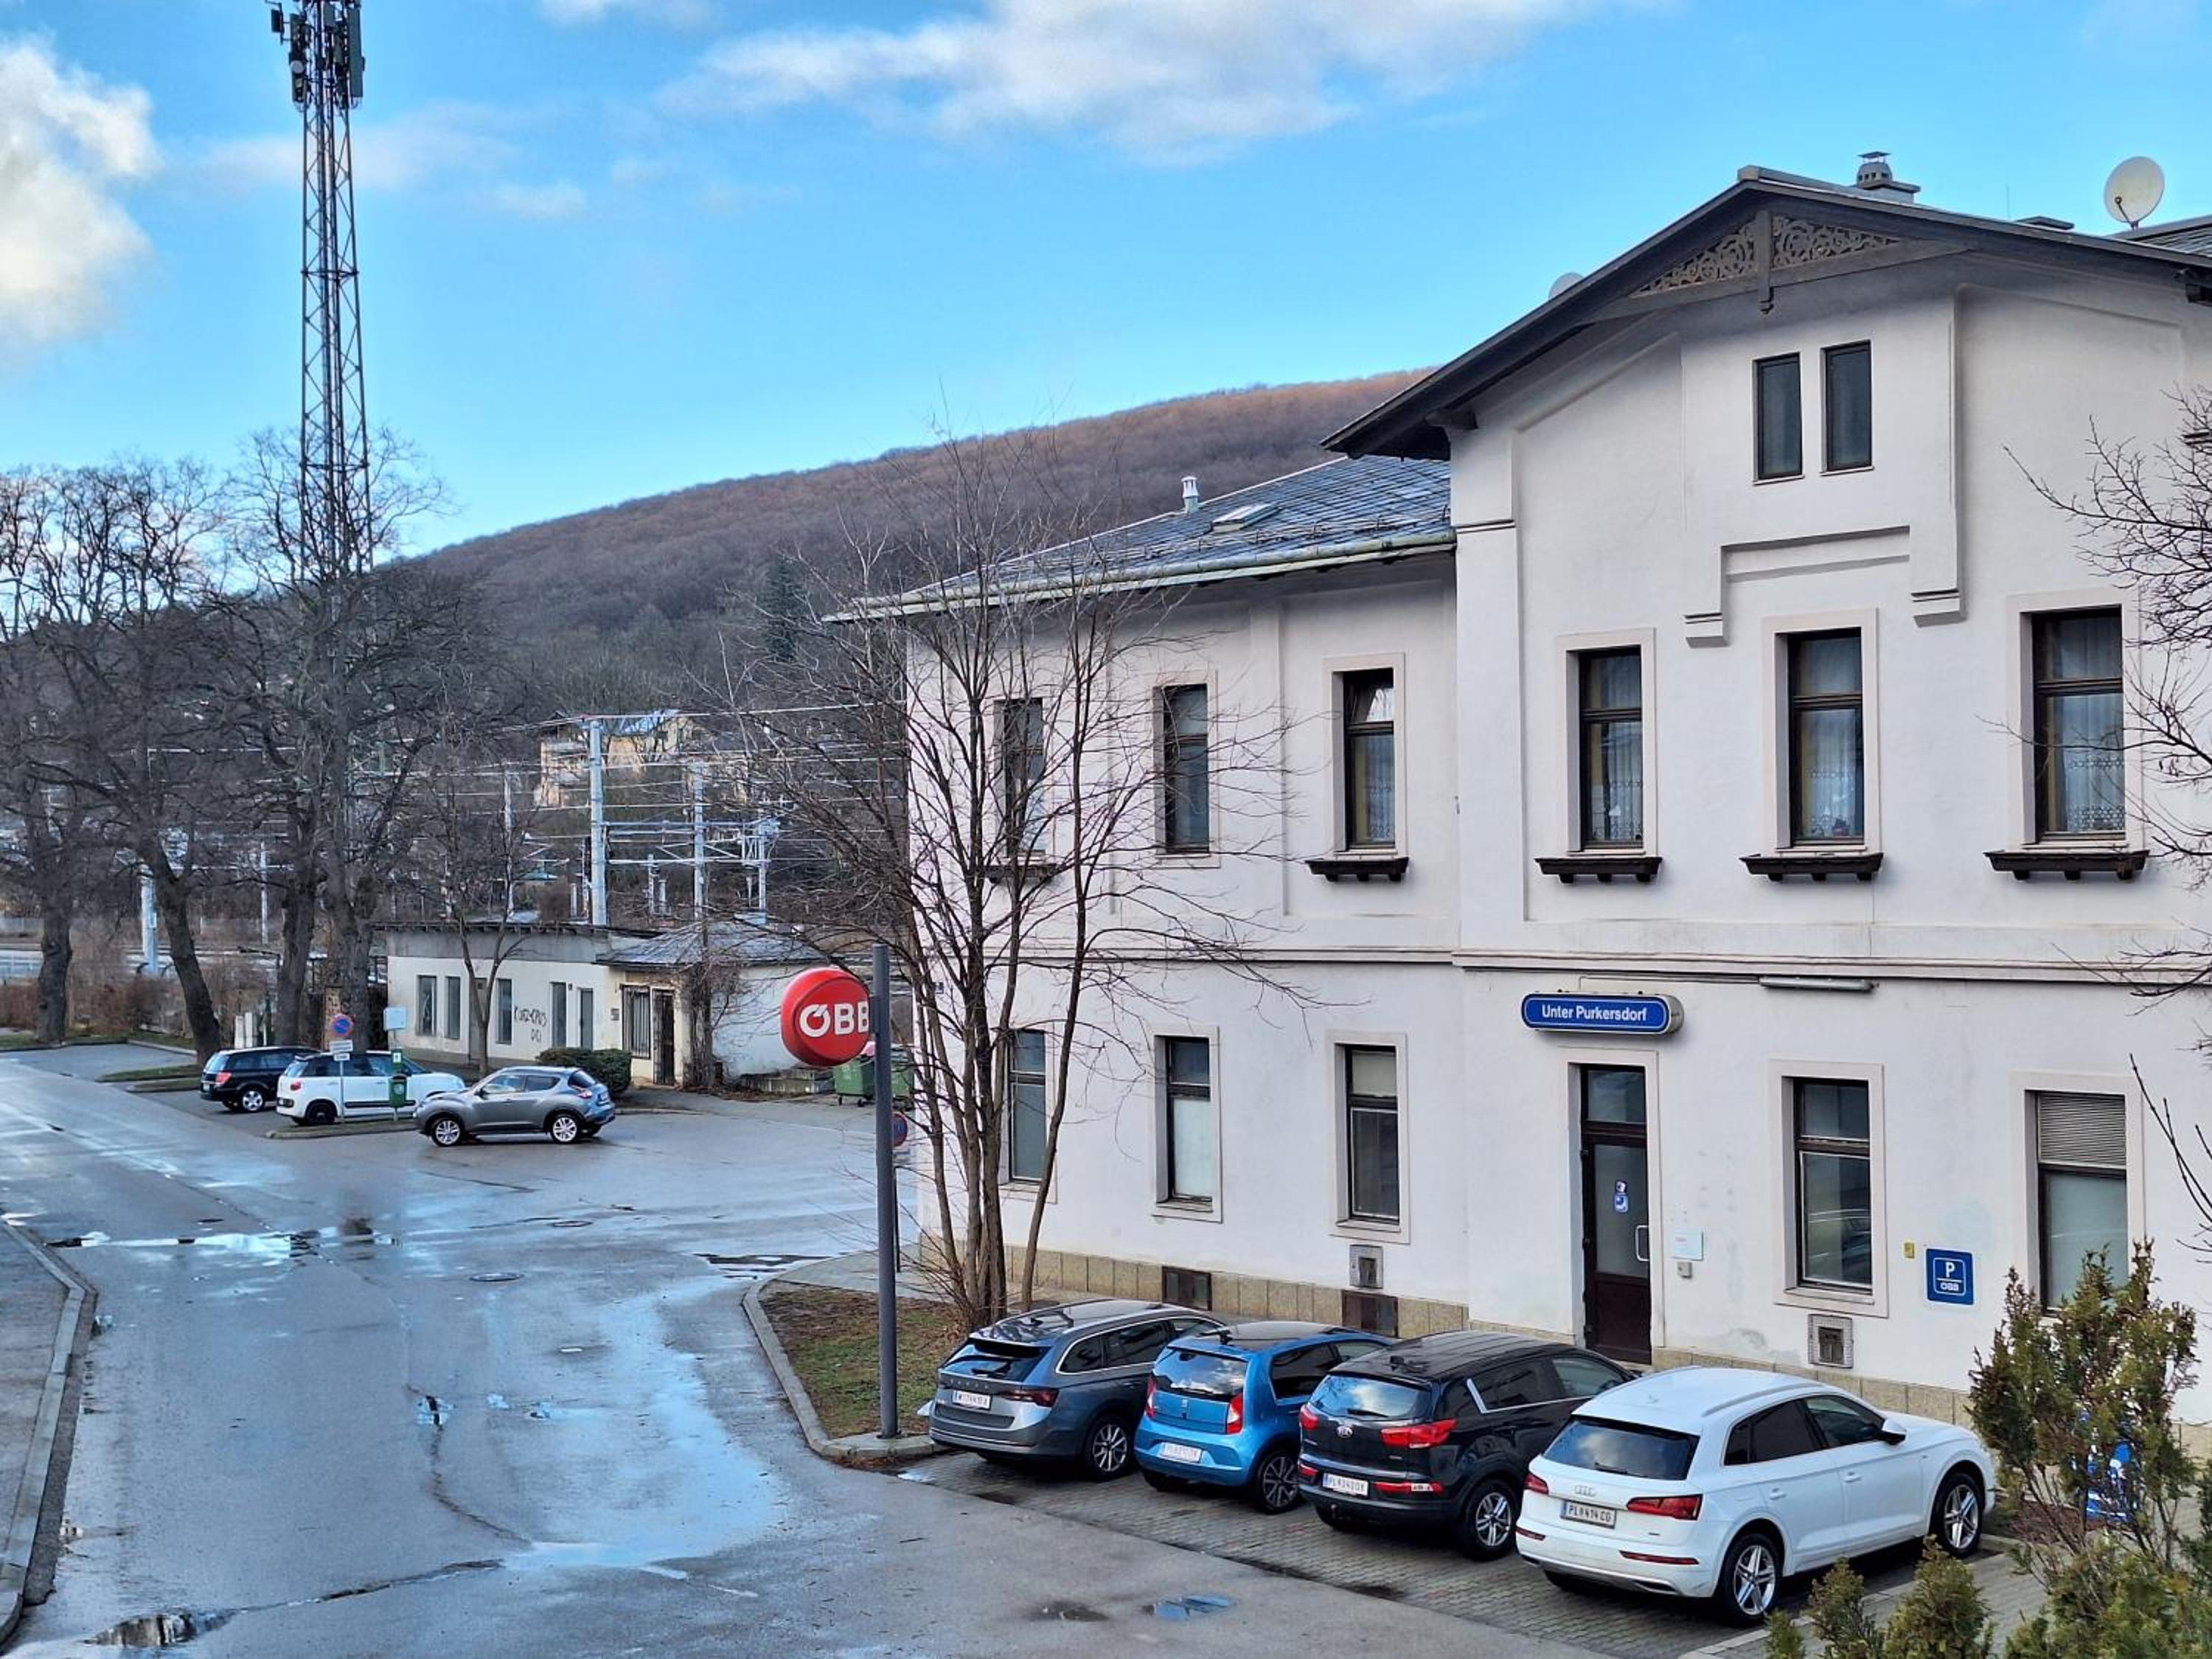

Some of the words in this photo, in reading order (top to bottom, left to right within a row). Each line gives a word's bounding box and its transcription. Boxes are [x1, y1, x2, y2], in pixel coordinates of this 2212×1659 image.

[1542, 1004, 1573, 1018] Unter
[1576, 1005, 1647, 1021] Purkersdorf
[1945, 1262, 1955, 1278] P
